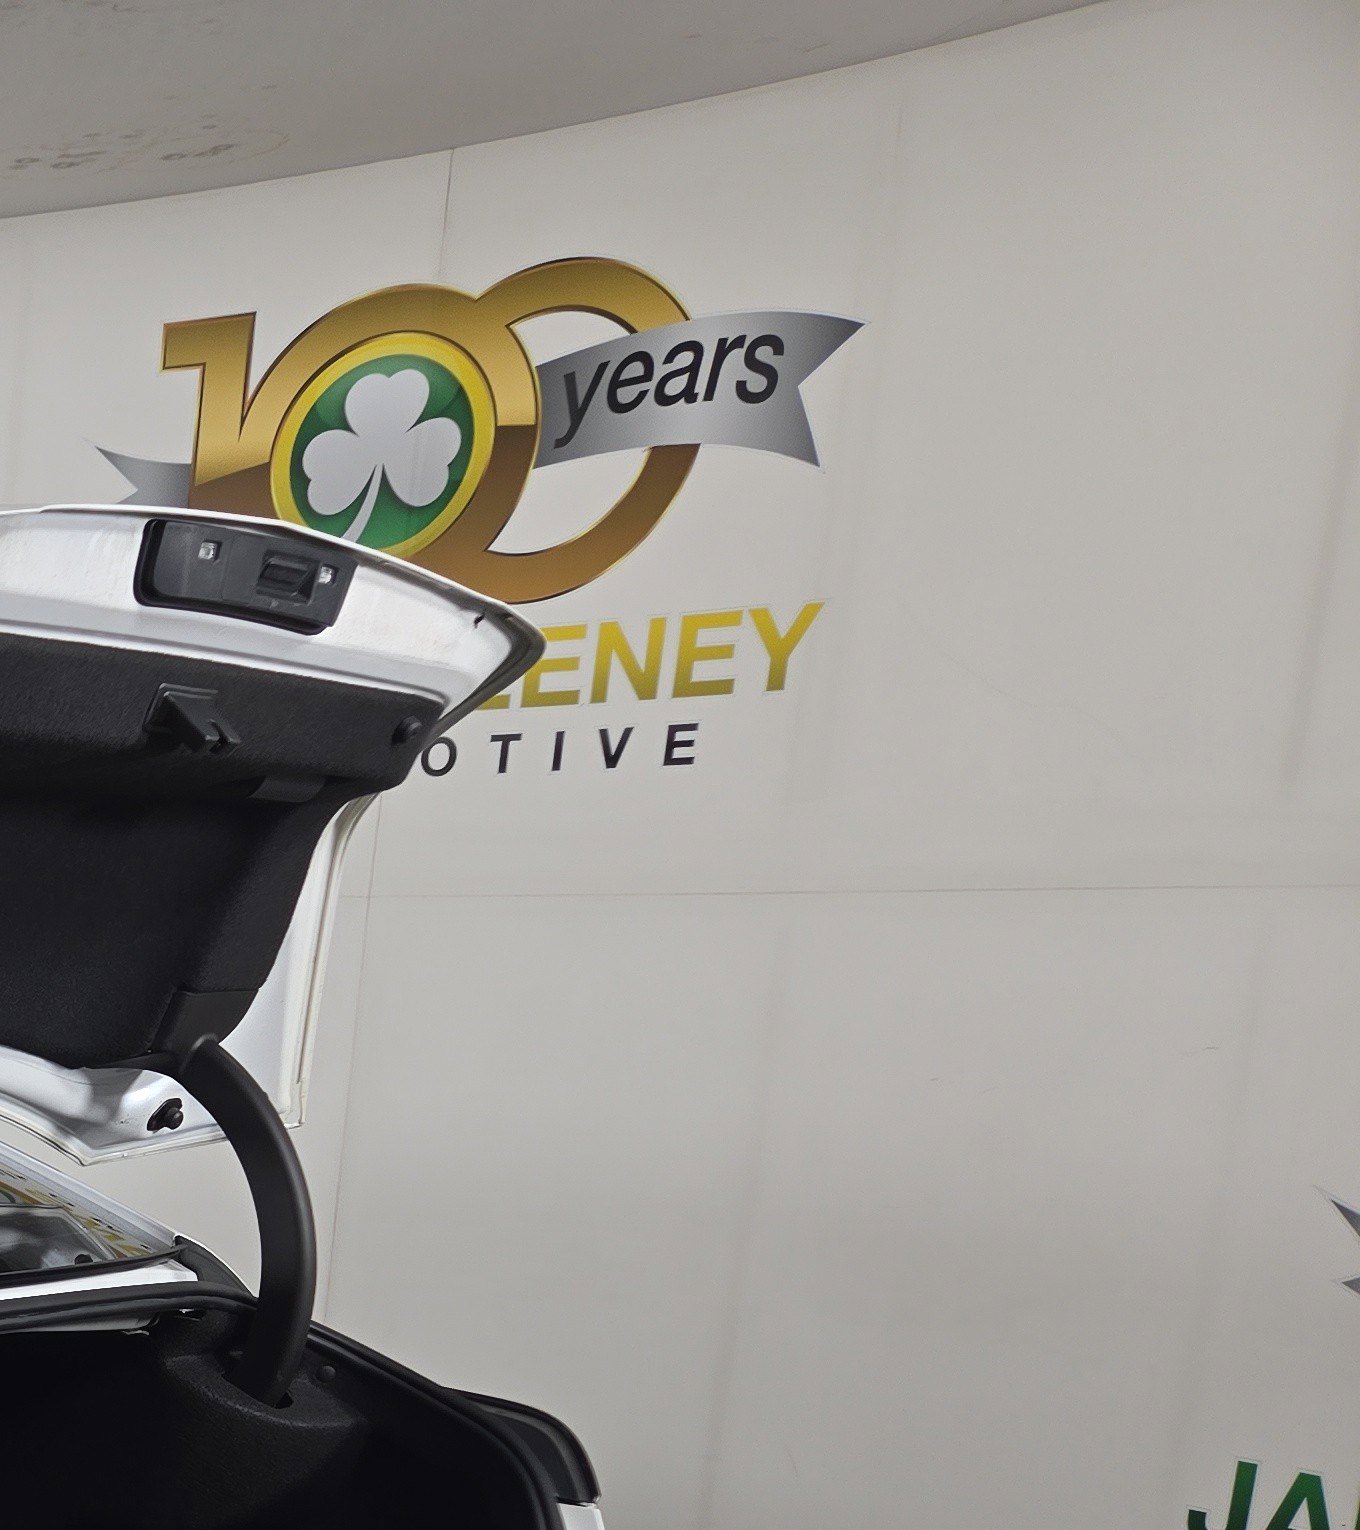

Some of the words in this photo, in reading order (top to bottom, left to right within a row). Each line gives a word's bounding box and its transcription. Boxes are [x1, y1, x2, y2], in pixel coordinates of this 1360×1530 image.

[552, 332, 785, 449] years
[476, 602, 825, 711] ENEY
[421, 722, 699, 777] OTIVE
